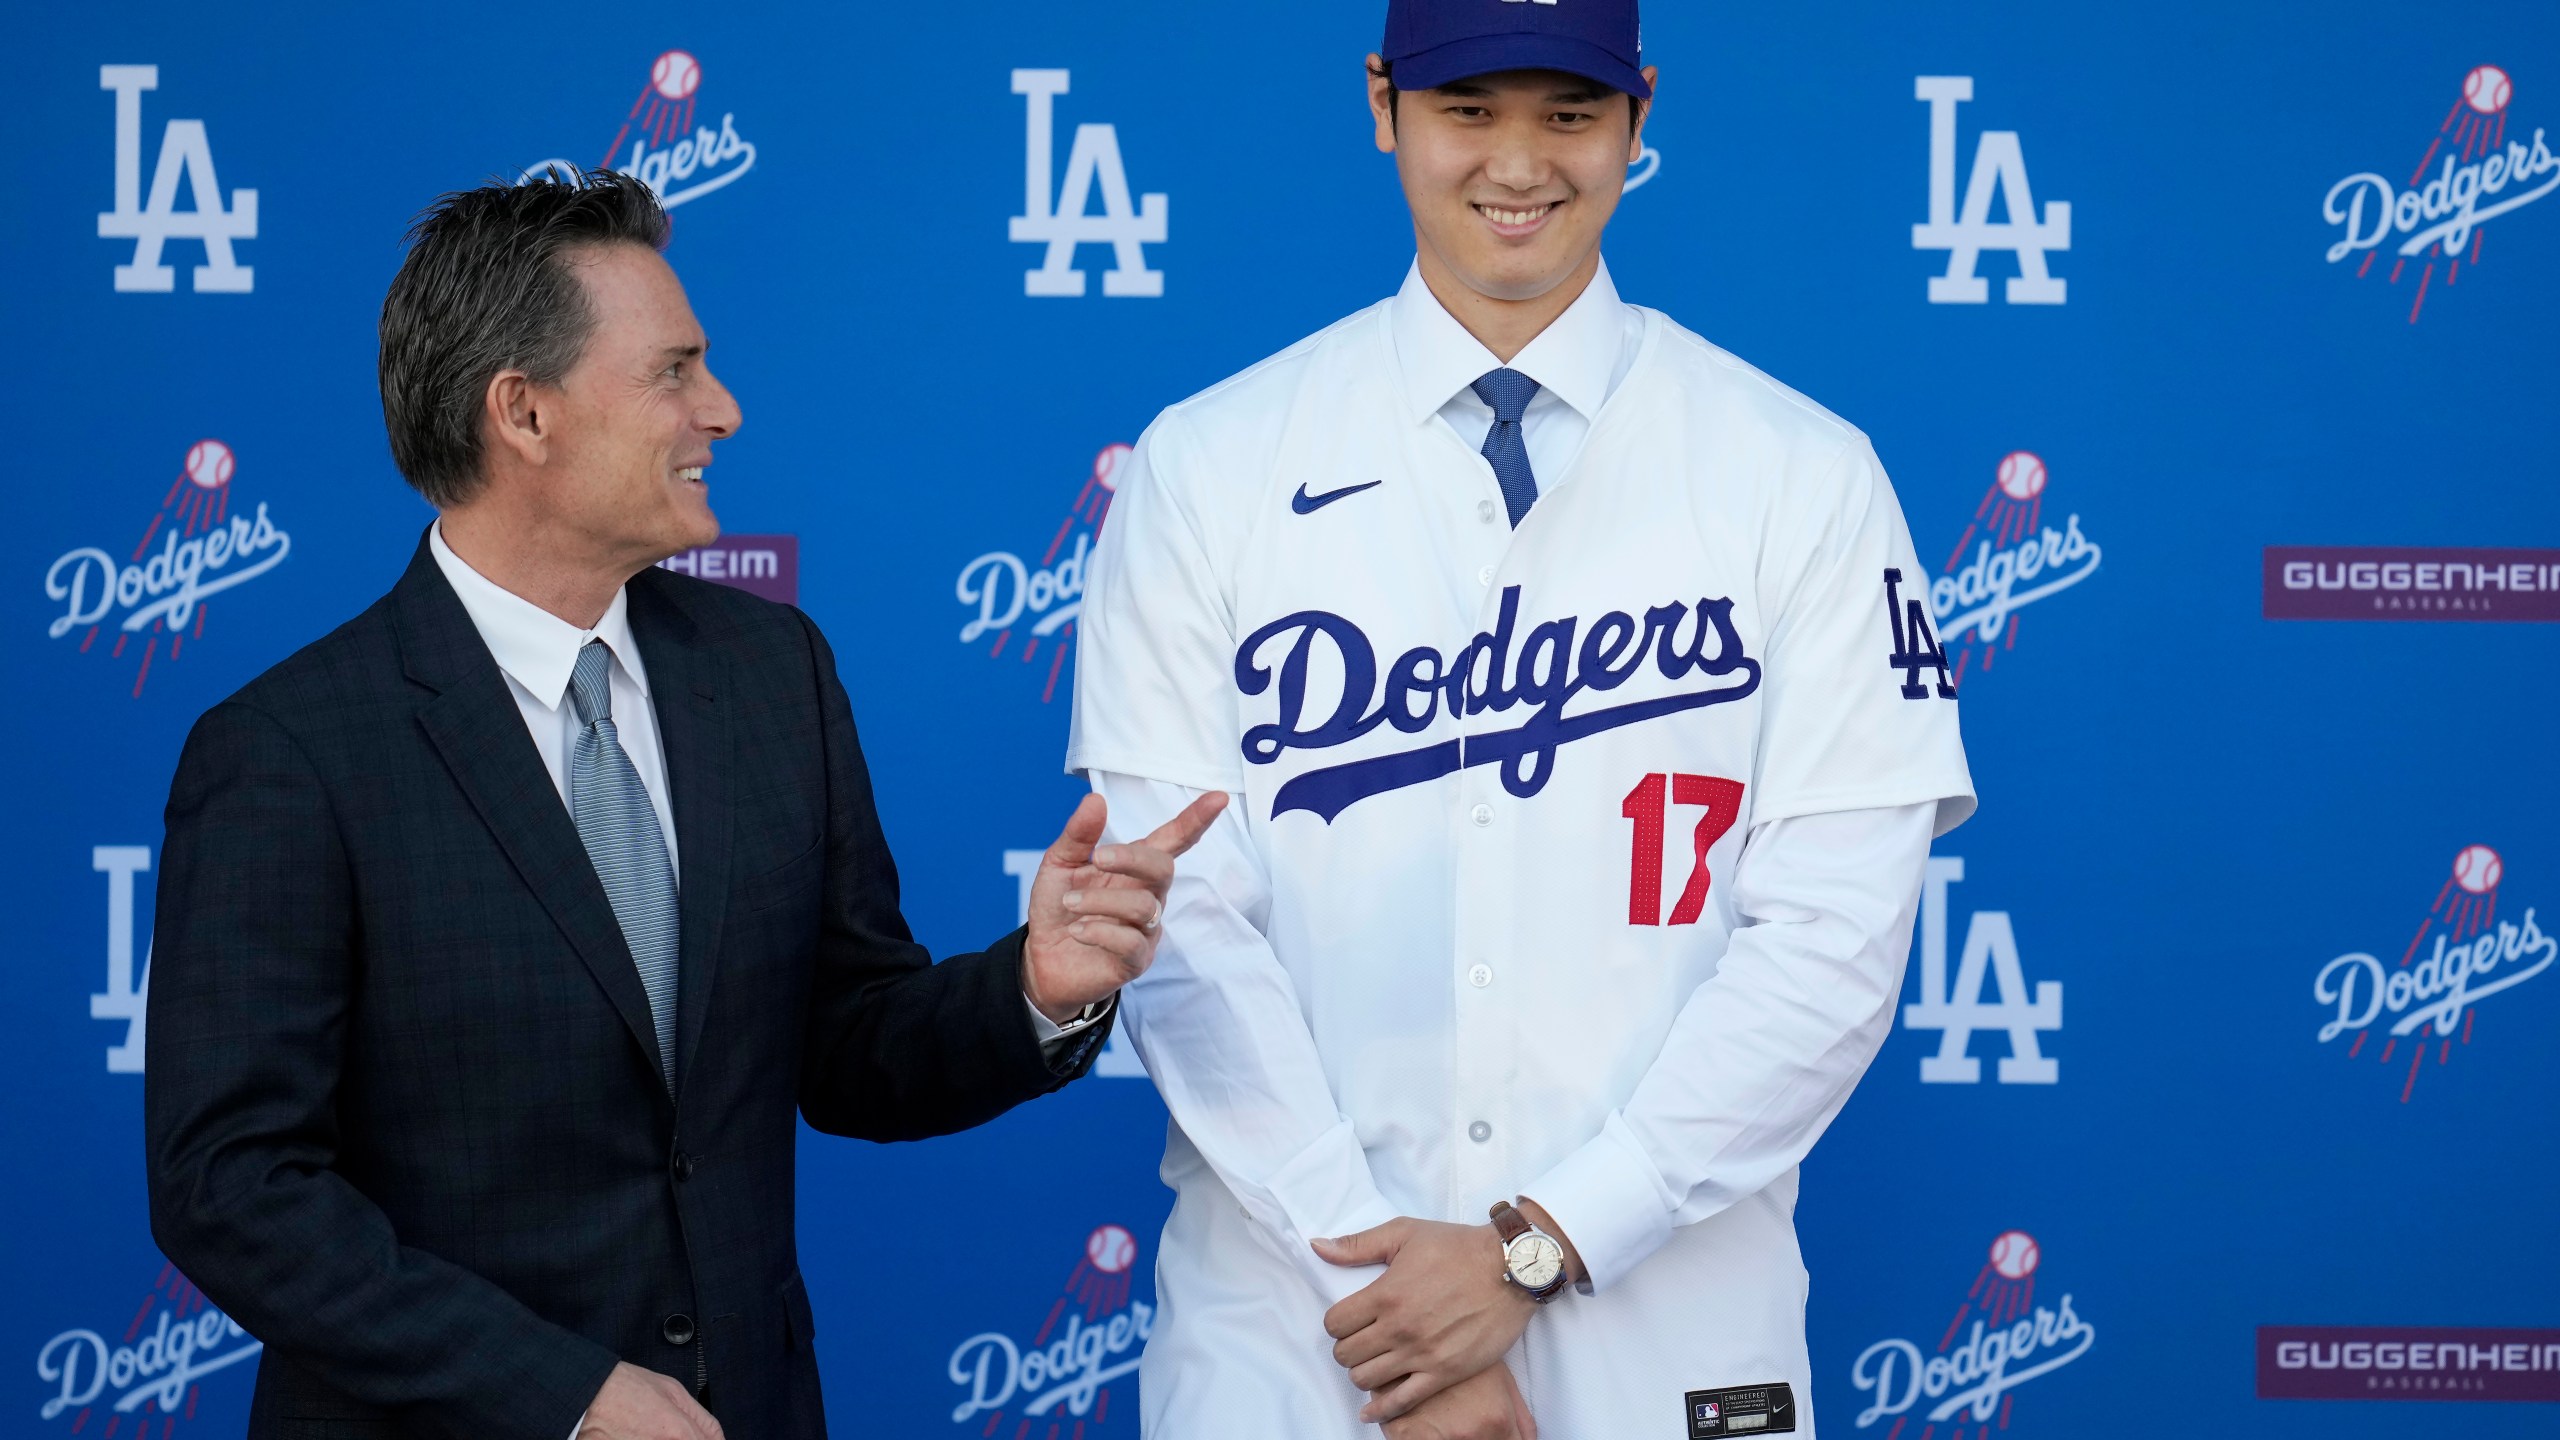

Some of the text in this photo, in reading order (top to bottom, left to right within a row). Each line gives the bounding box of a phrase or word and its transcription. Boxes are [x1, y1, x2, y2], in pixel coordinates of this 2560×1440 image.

[98, 65, 258, 293] LA
[515, 112, 757, 210] dgers
[1009, 69, 1168, 297] LA
[1912, 76, 2071, 304] LA
[2323, 128, 2560, 262] Dodgers
[46, 503, 290, 638] Dodgers
[655, 550, 778, 578] HEIM
[956, 532, 1095, 643] Dod
[1920, 513, 2102, 642] odgers
[2283, 562, 2560, 591] GUGGENHEI
[2374, 596, 2491, 610] BASEBALL
[1884, 568, 1958, 700] LA
[1235, 584, 1761, 825] Dodgers
[1622, 772, 1745, 926] 17
[1903, 856, 2063, 1084] LA
[2313, 907, 2557, 1043] Dodgers
[37, 1309, 264, 1420] Dodge
[948, 1300, 1155, 1423] Dodger
[1852, 1294, 2094, 1428] Dodgers
